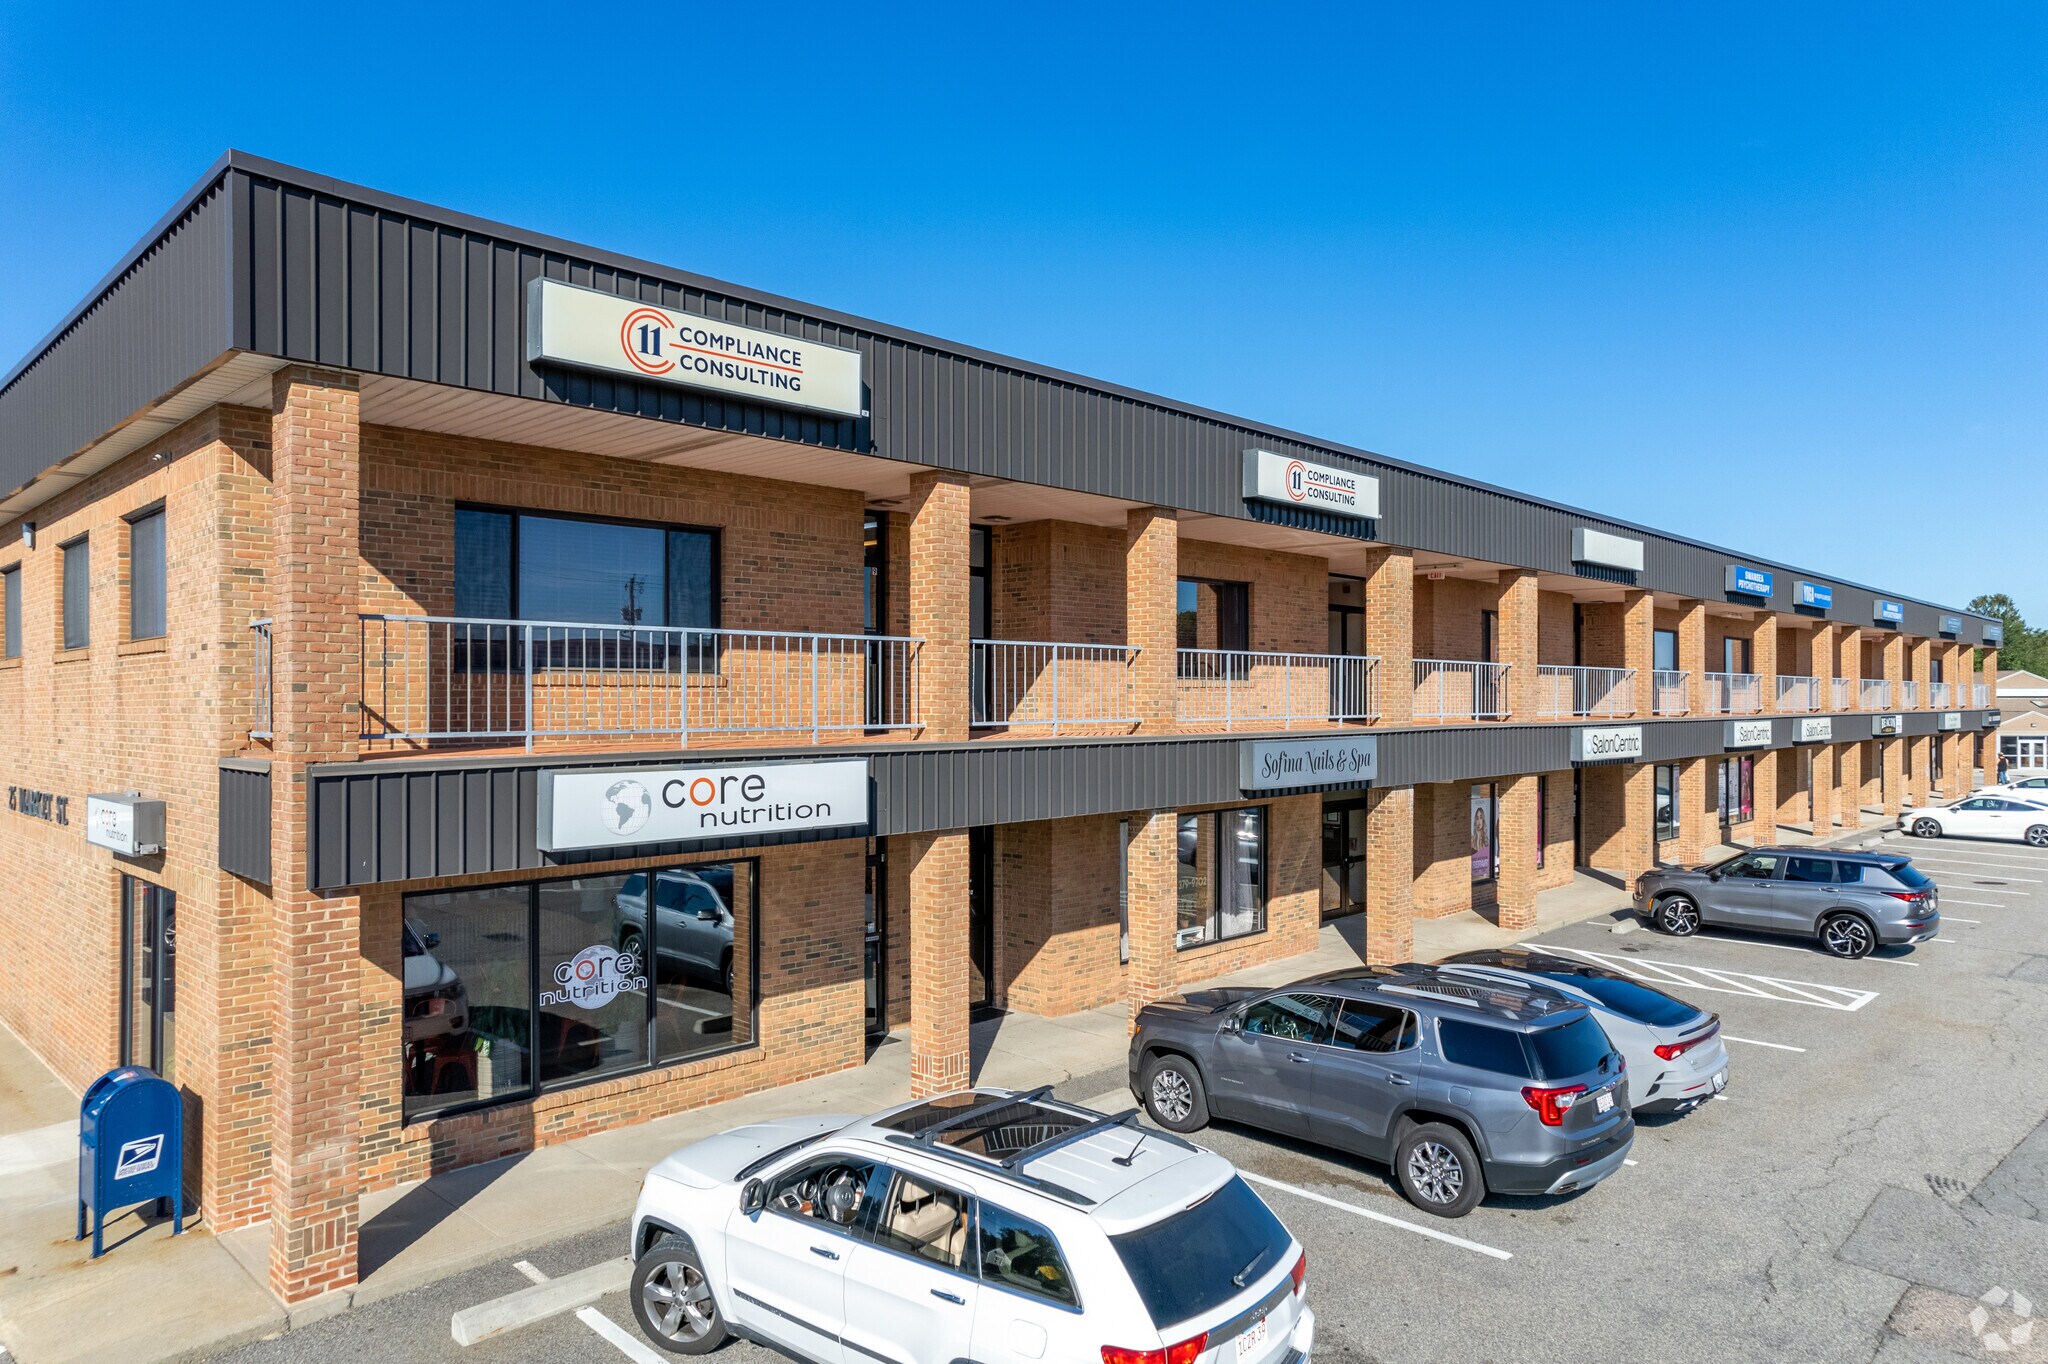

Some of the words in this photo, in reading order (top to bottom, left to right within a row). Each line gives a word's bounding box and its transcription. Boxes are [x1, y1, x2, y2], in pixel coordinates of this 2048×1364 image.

[637, 323, 663, 358] 11
[680, 326, 802, 367] COMPLIANCE
[680, 354, 802, 392] CONSULTING
[1292, 471, 1302, 490] 11
[1307, 470, 1355, 490] COMPLIANCE
[1307, 487, 1355, 506] CONSULTING
[1738, 579, 1770, 593] PSYCHOTHERAPY
[1745, 571, 1764, 583] SWANSEA
[1803, 585, 1815, 603] YOGA
[1261, 750, 1303, 780] Sofina
[1305, 748, 1335, 774] Nails
[1336, 748, 1347, 772] &
[1348, 747, 1371, 773] Spa
[662, 773, 766, 809] core
[700, 801, 831, 828] nutrition
[106, 829, 127, 842] nutrition
[554, 953, 634, 984] core
[540, 976, 648, 1006] nutrition
[1257, 1323, 1266, 1342] 39
